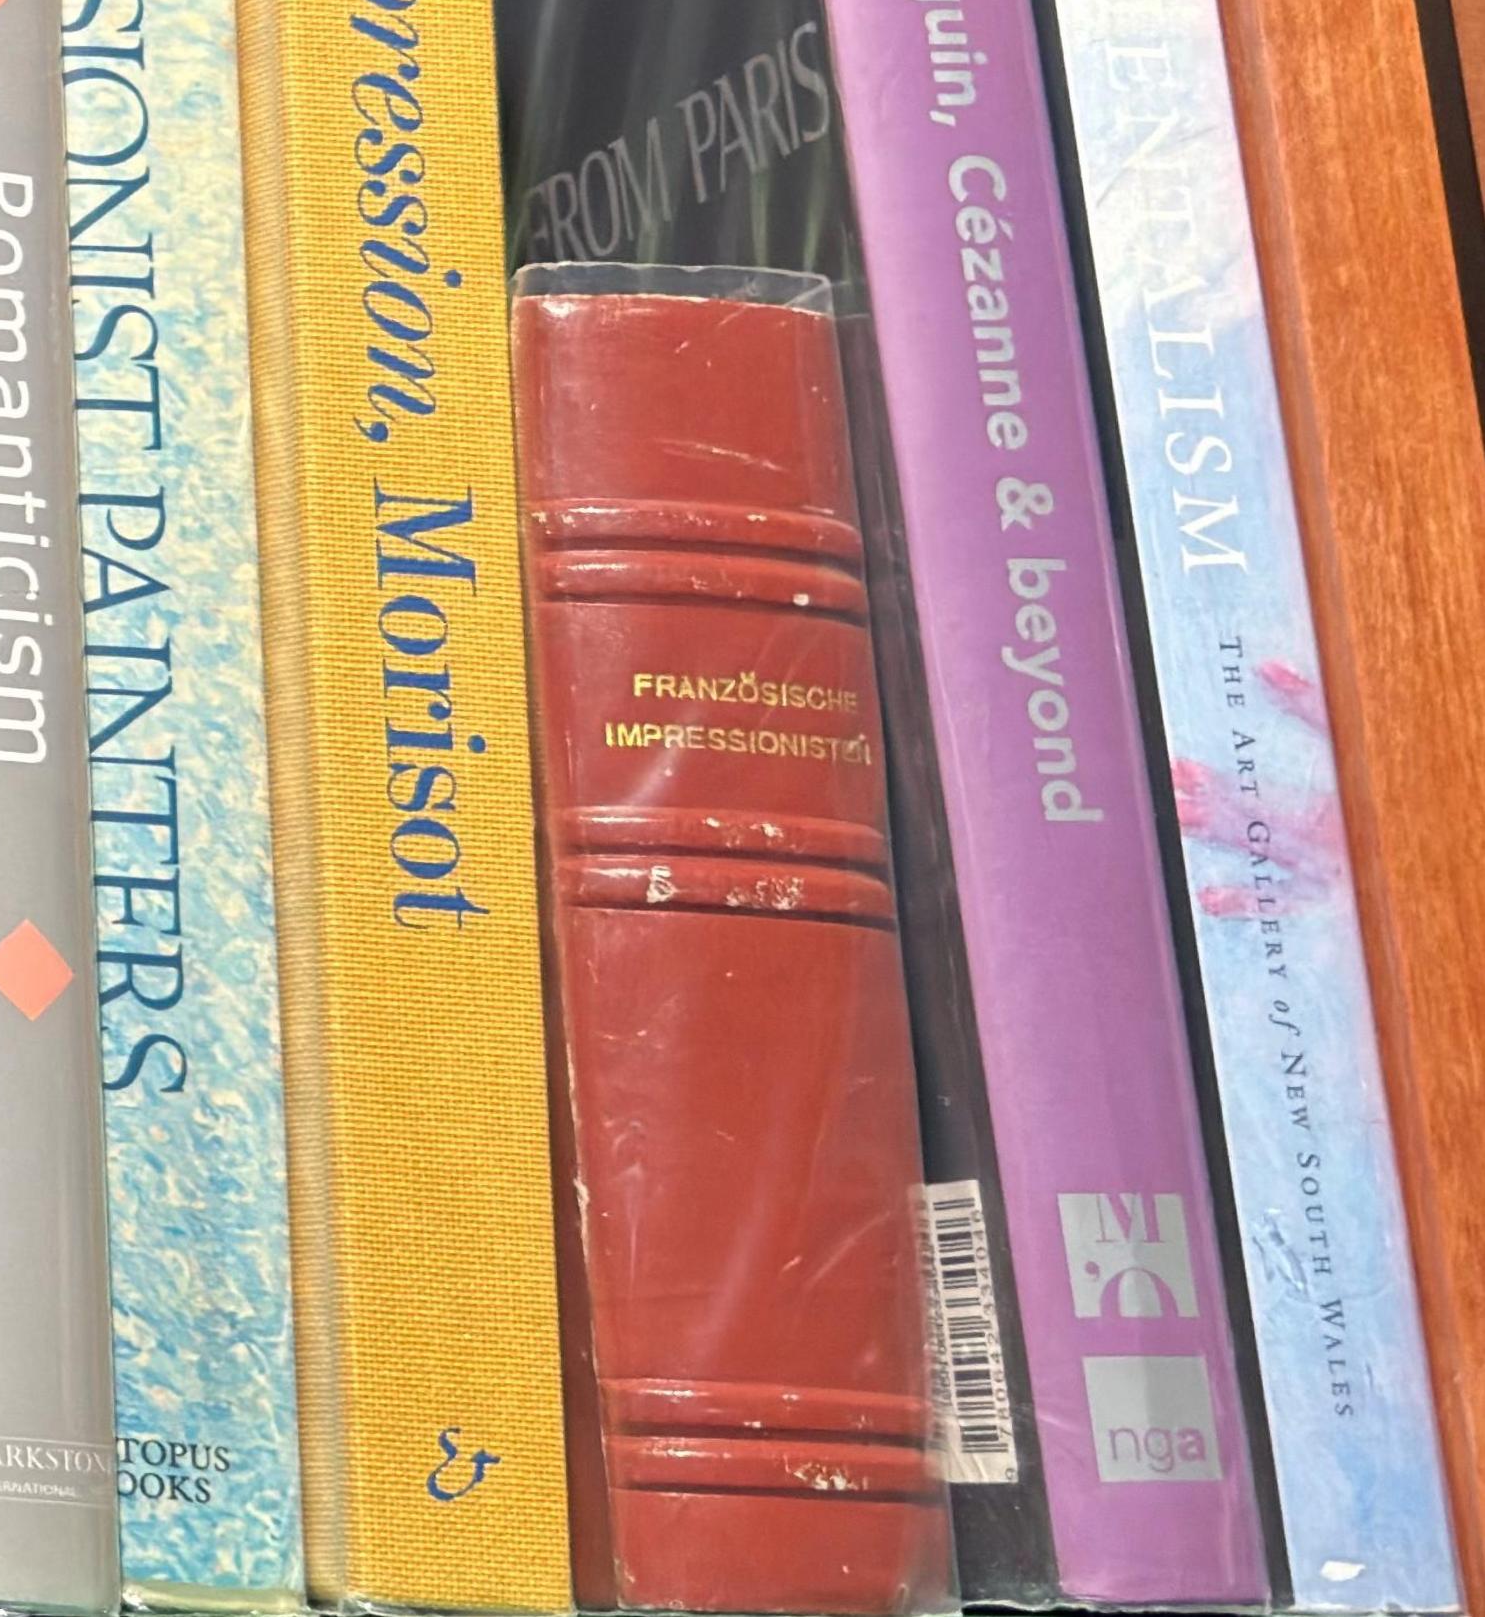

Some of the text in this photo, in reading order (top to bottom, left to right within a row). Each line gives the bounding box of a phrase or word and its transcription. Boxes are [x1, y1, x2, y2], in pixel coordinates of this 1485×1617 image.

[675, 20, 832, 204] PARIS
[948, 154, 1030, 451] Cézanne
[995, 476, 1054, 532] &
[373, 476, 490, 932] Morisot
[632, 671, 858, 711] FRANZÖSISCHE
[1001, 556, 1104, 824] beyond
[75, 486, 188, 1096] PAINTERS
[1218, 635, 1355, 1418] THE ART GALLERY of NEW SOUTH WALES
[116, 1437, 231, 1472] TOPUS
[116, 1471, 212, 1504] OOKS
[1108, 1426, 1206, 1474] nga
